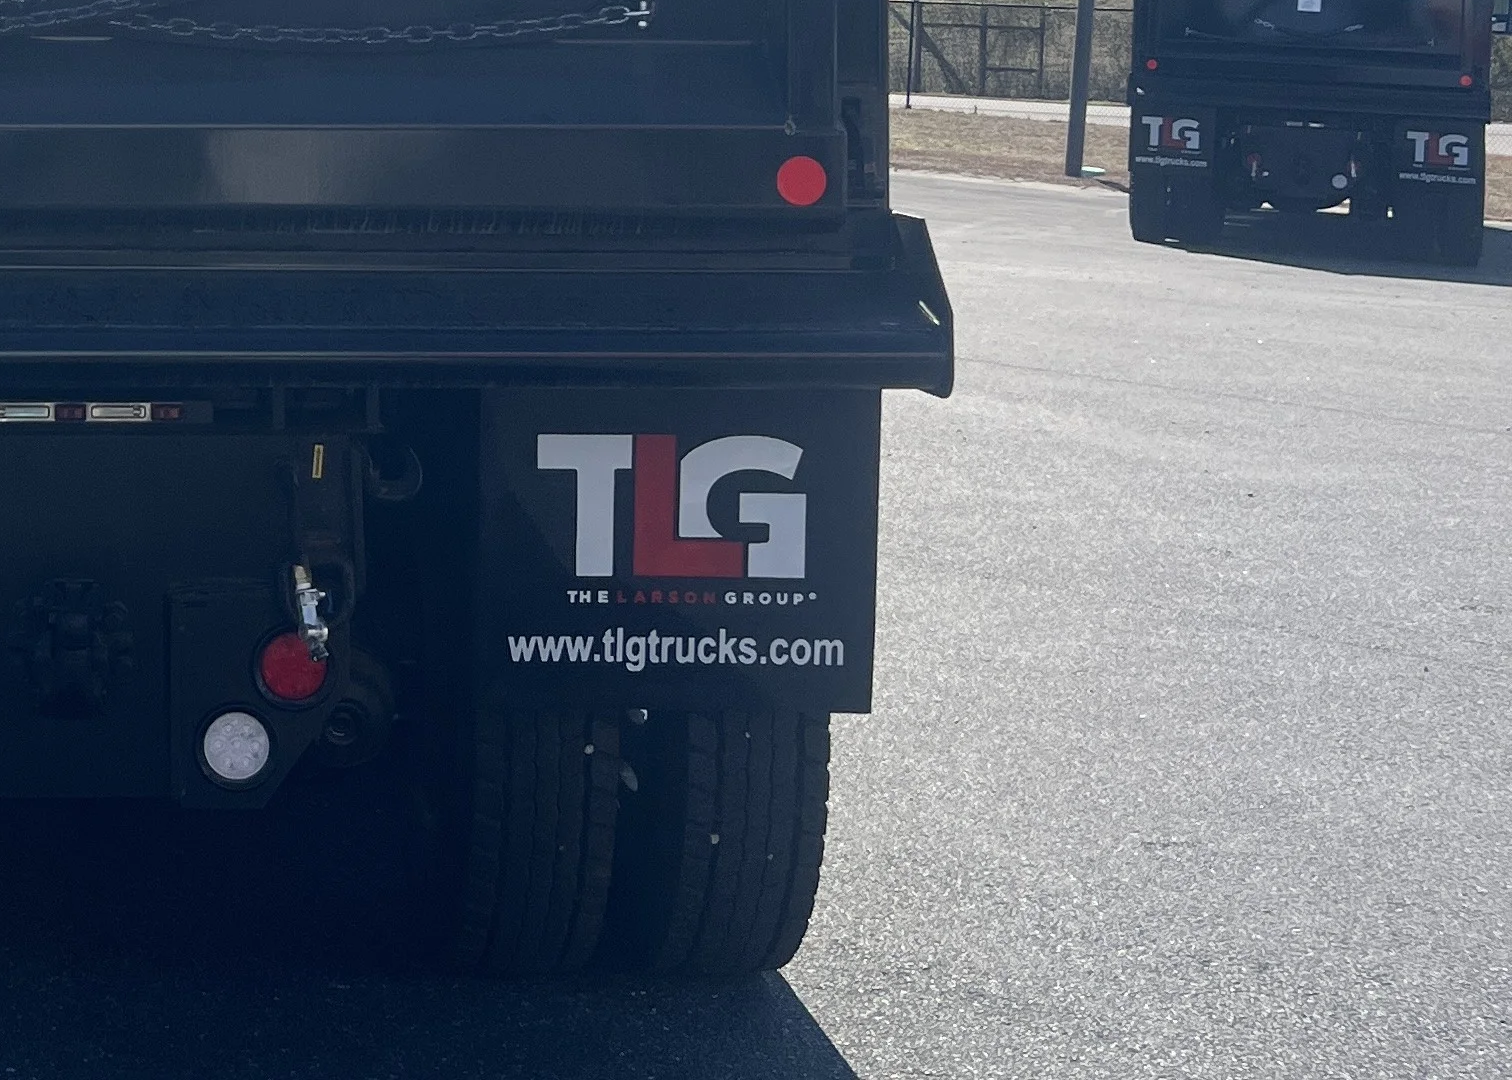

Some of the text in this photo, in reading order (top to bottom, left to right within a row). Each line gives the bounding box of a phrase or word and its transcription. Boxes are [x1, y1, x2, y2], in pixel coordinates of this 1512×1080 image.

[1141, 116, 1200, 149] TLG
[1407, 131, 1469, 166] TLG
[537, 434, 807, 579] TLG
[567, 589, 609, 604] THE
[617, 590, 717, 605] LARSON
[508, 627, 844, 672] www.tlgtrucks.com
